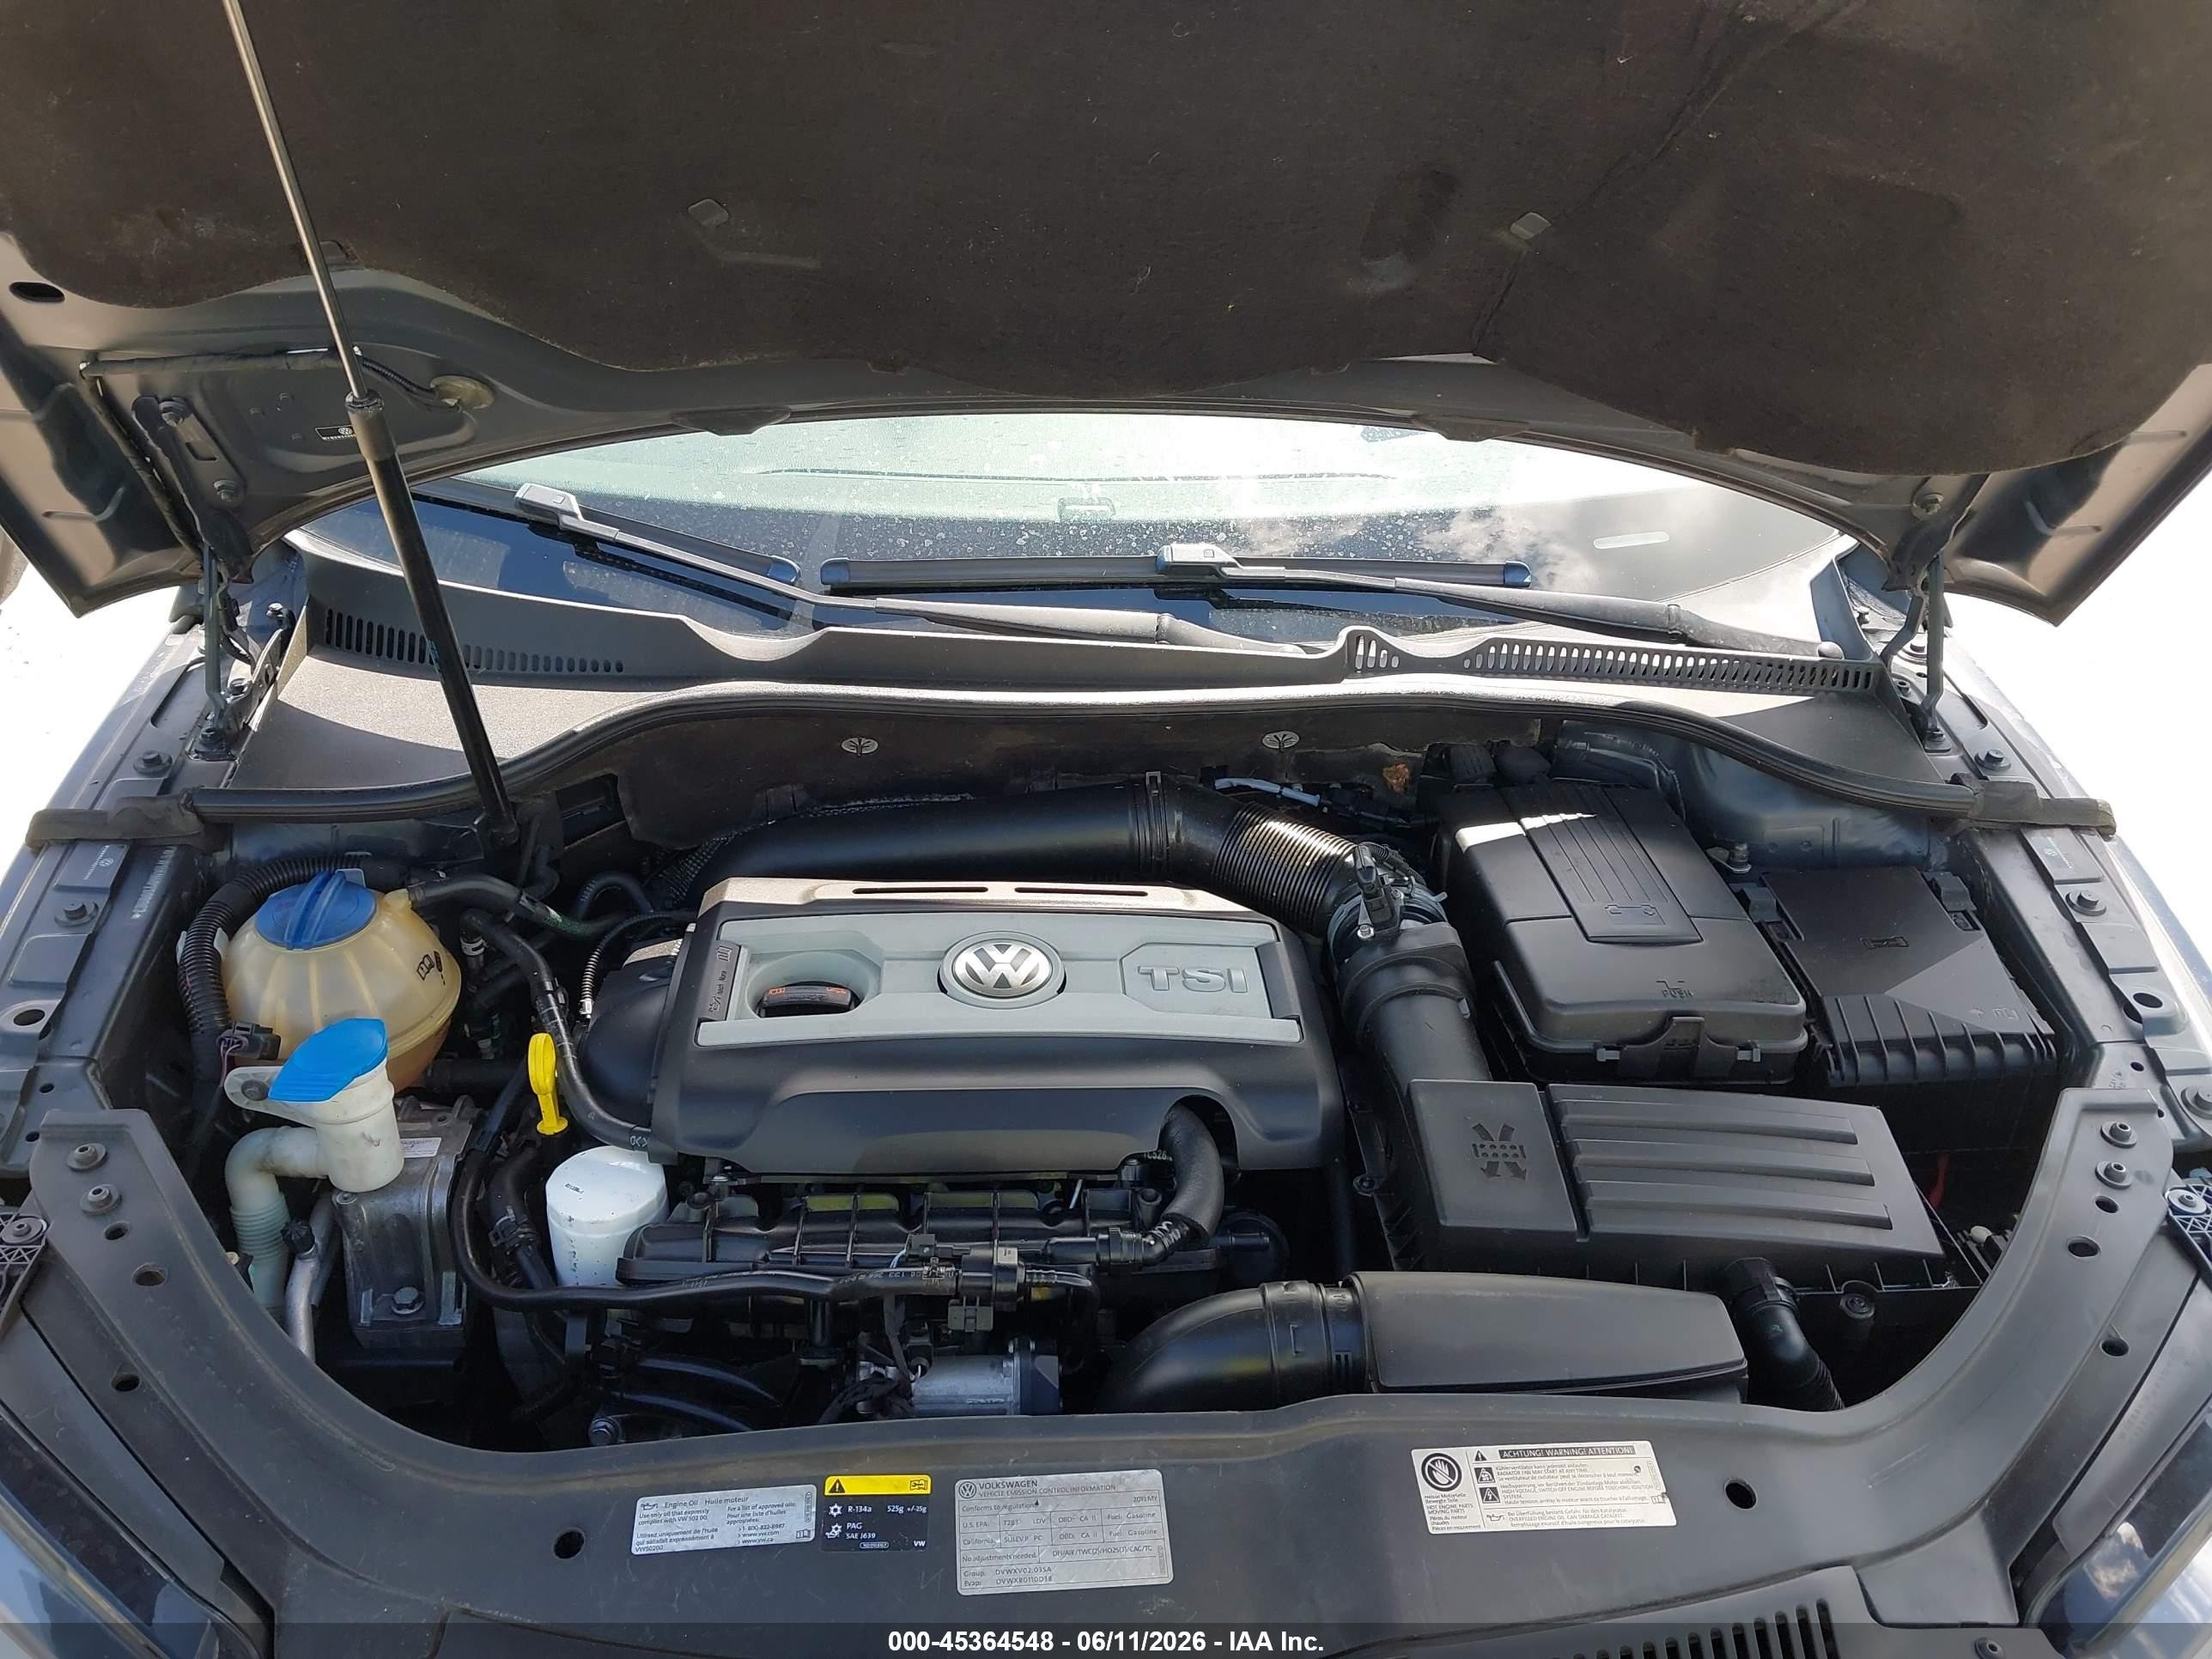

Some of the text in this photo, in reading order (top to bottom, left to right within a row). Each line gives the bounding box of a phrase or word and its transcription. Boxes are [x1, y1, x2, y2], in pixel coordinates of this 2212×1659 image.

[1138, 965, 1248, 994] TSI
[1503, 1446, 1634, 1458] ACHTUNG! WARNING! ATTENTION!
[978, 1479, 1038, 1489] VOLKSWAGEN
[1070, 1483, 1115, 1492] INFORMATION
[664, 1500, 687, 1509] Engine
[887, 1505, 904, 1513] 525g
[906, 1505, 927, 1513] +/-25g
